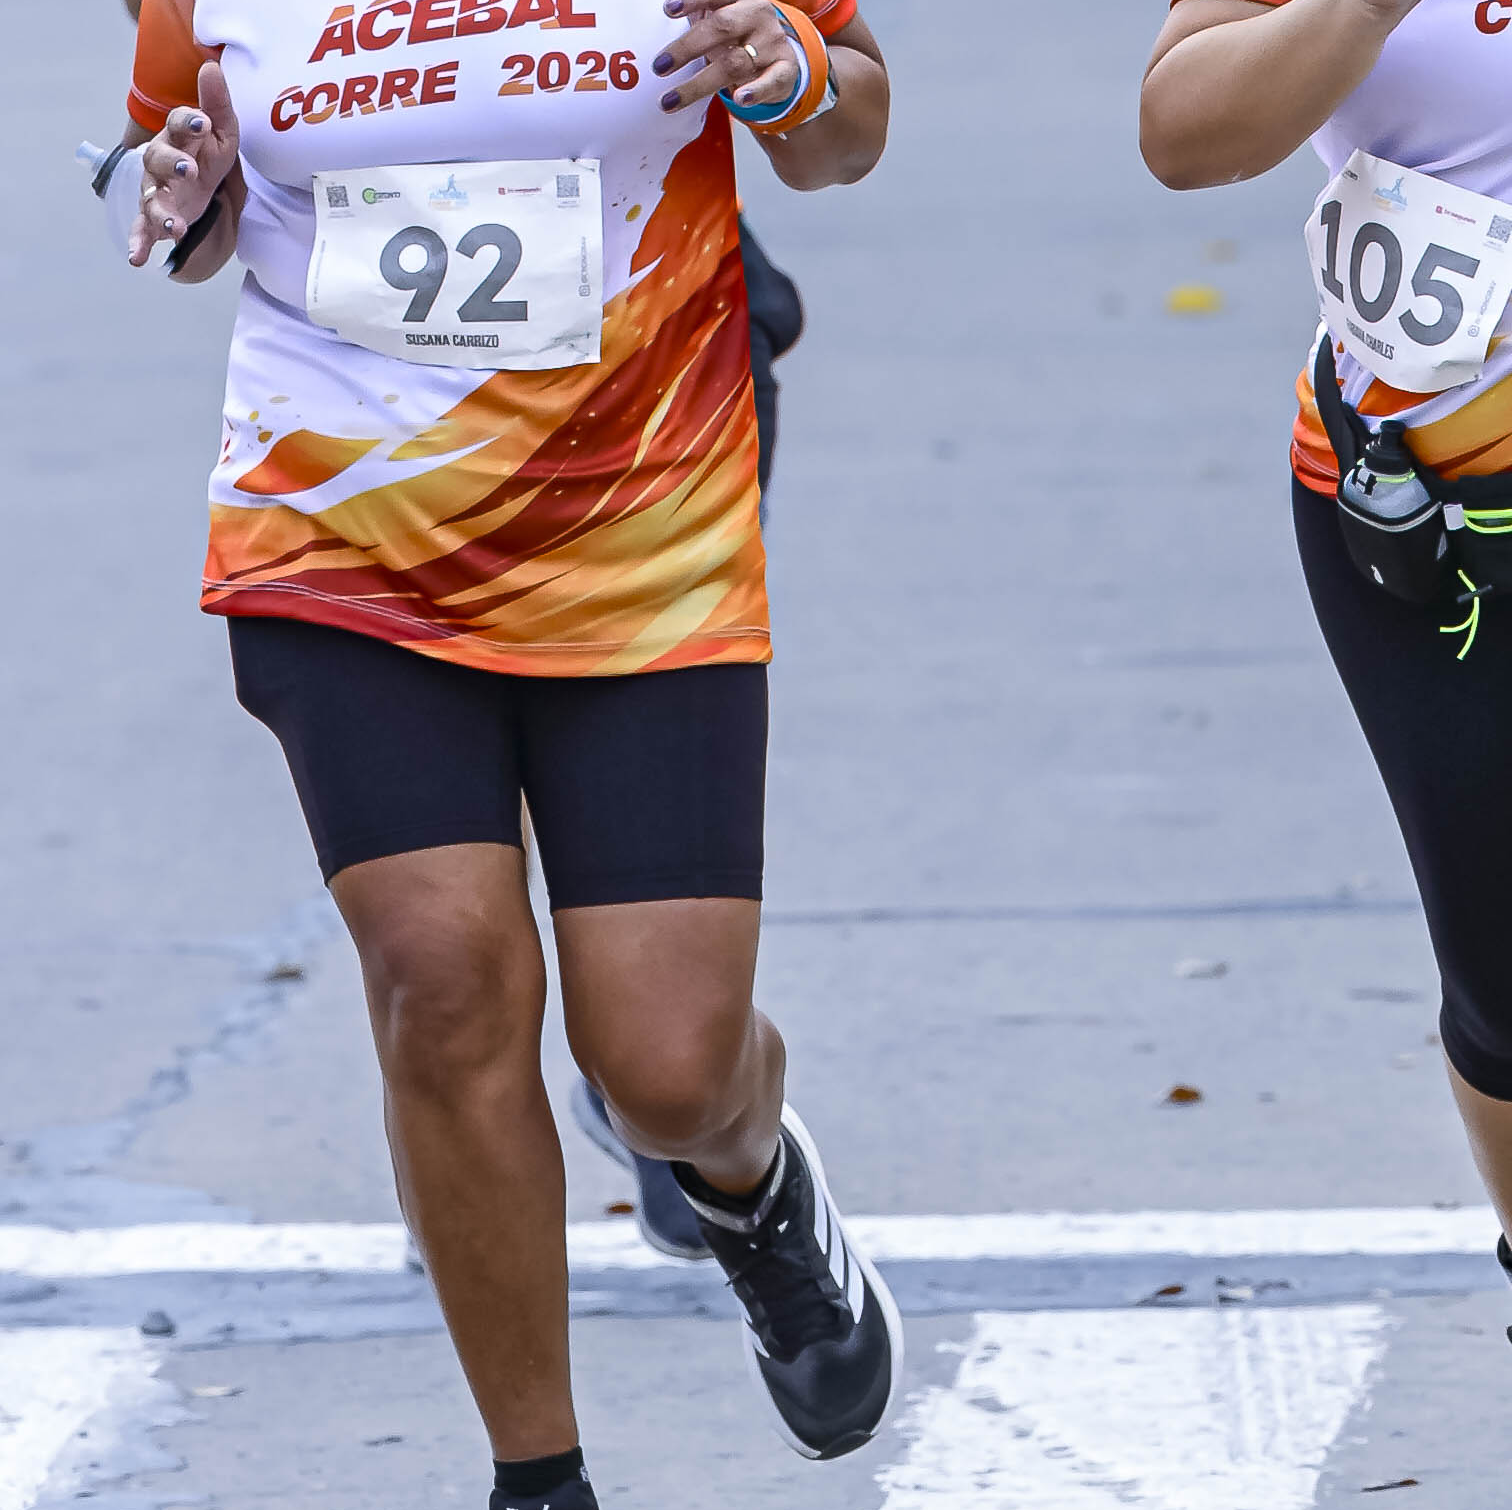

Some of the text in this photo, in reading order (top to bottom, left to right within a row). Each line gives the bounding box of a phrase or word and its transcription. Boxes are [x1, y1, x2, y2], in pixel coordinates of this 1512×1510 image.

[270, 51, 640, 132] CORRE 2026
[379, 223, 528, 322] 92
[1320, 200, 1480, 346] 105
[405, 333, 499, 348] SUSANA CARRIZO
